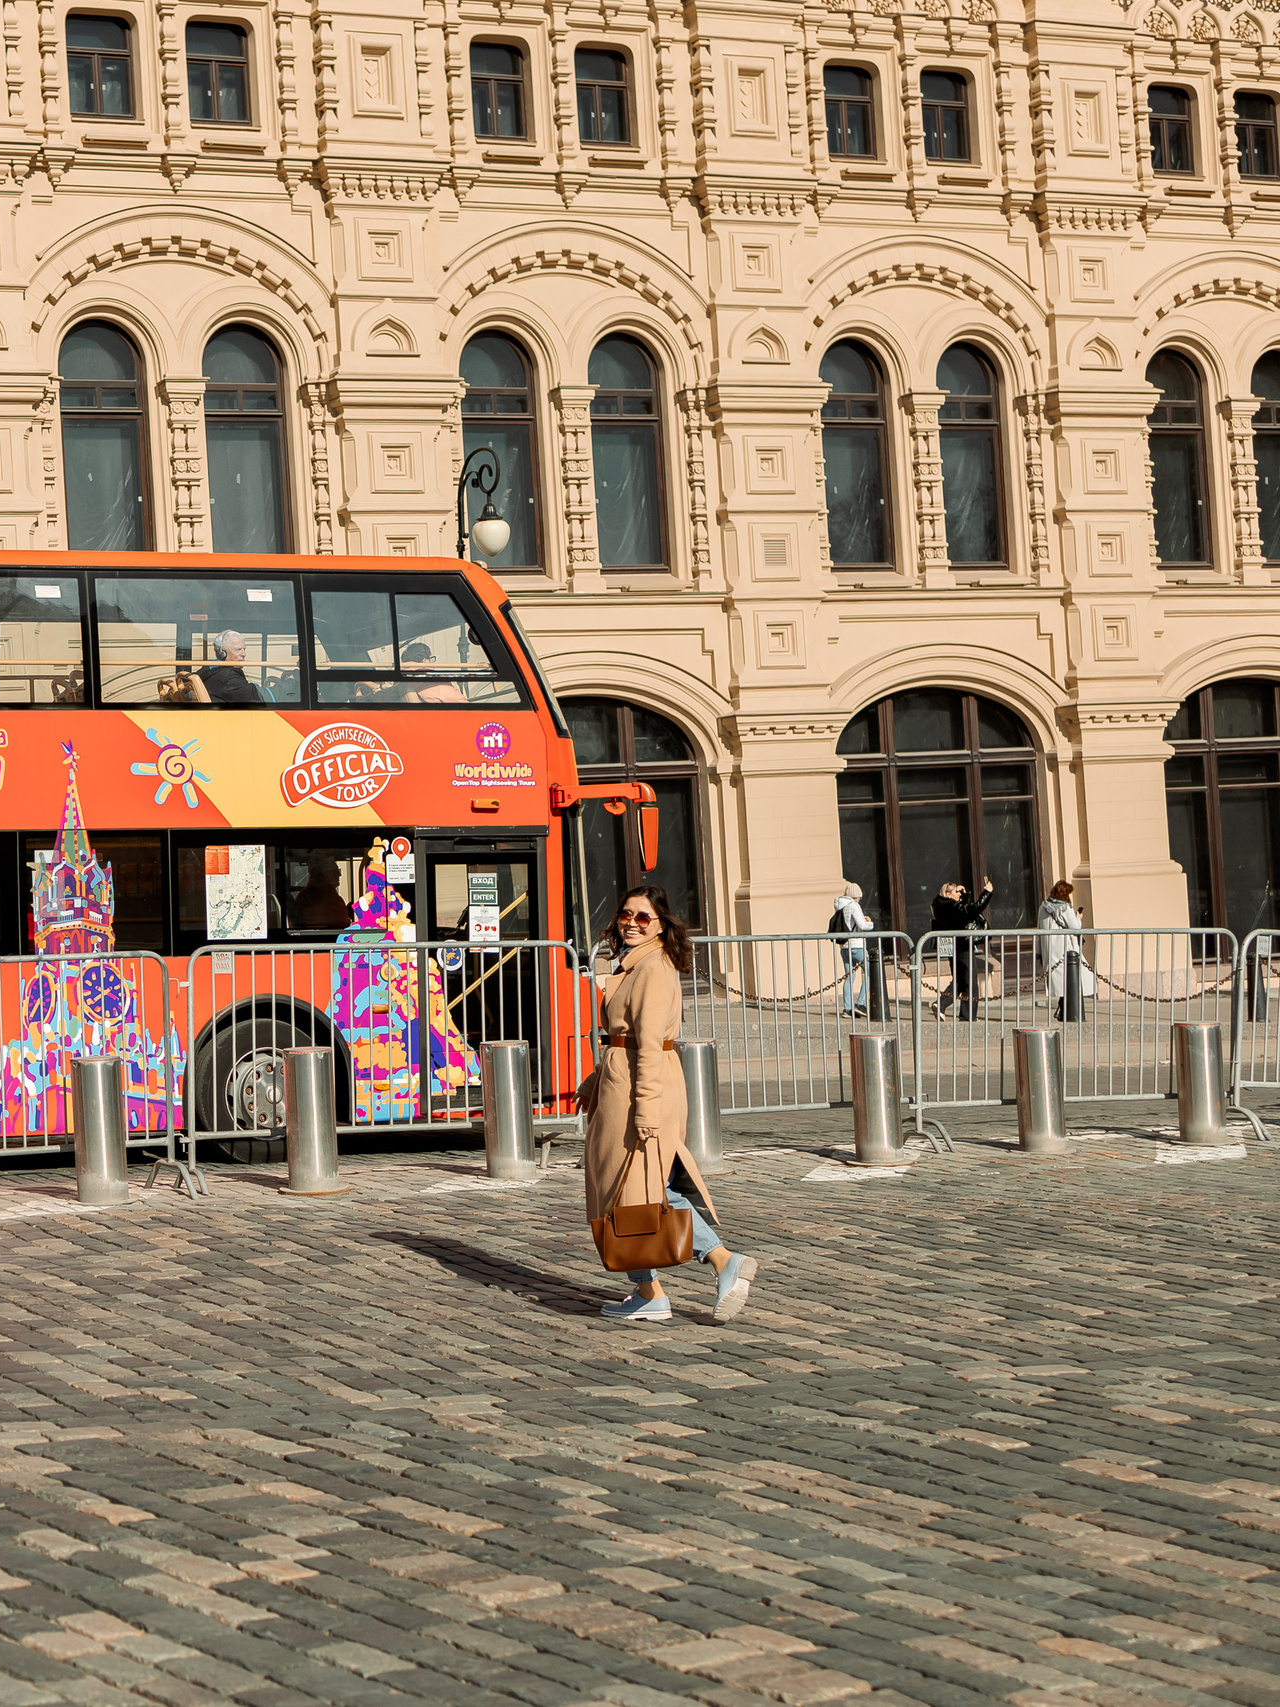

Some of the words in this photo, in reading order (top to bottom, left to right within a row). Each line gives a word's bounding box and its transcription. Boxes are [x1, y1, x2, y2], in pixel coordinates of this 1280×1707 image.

[308, 737, 325, 756] CITY
[323, 728, 377, 748] SIGHTSEEING
[293, 753, 399, 795] OFFICIAL
[454, 762, 533, 779] Worldwide
[336, 778, 380, 801] TOUR
[472, 877, 495, 885] ВХОД
[472, 893, 495, 901] ENTER
